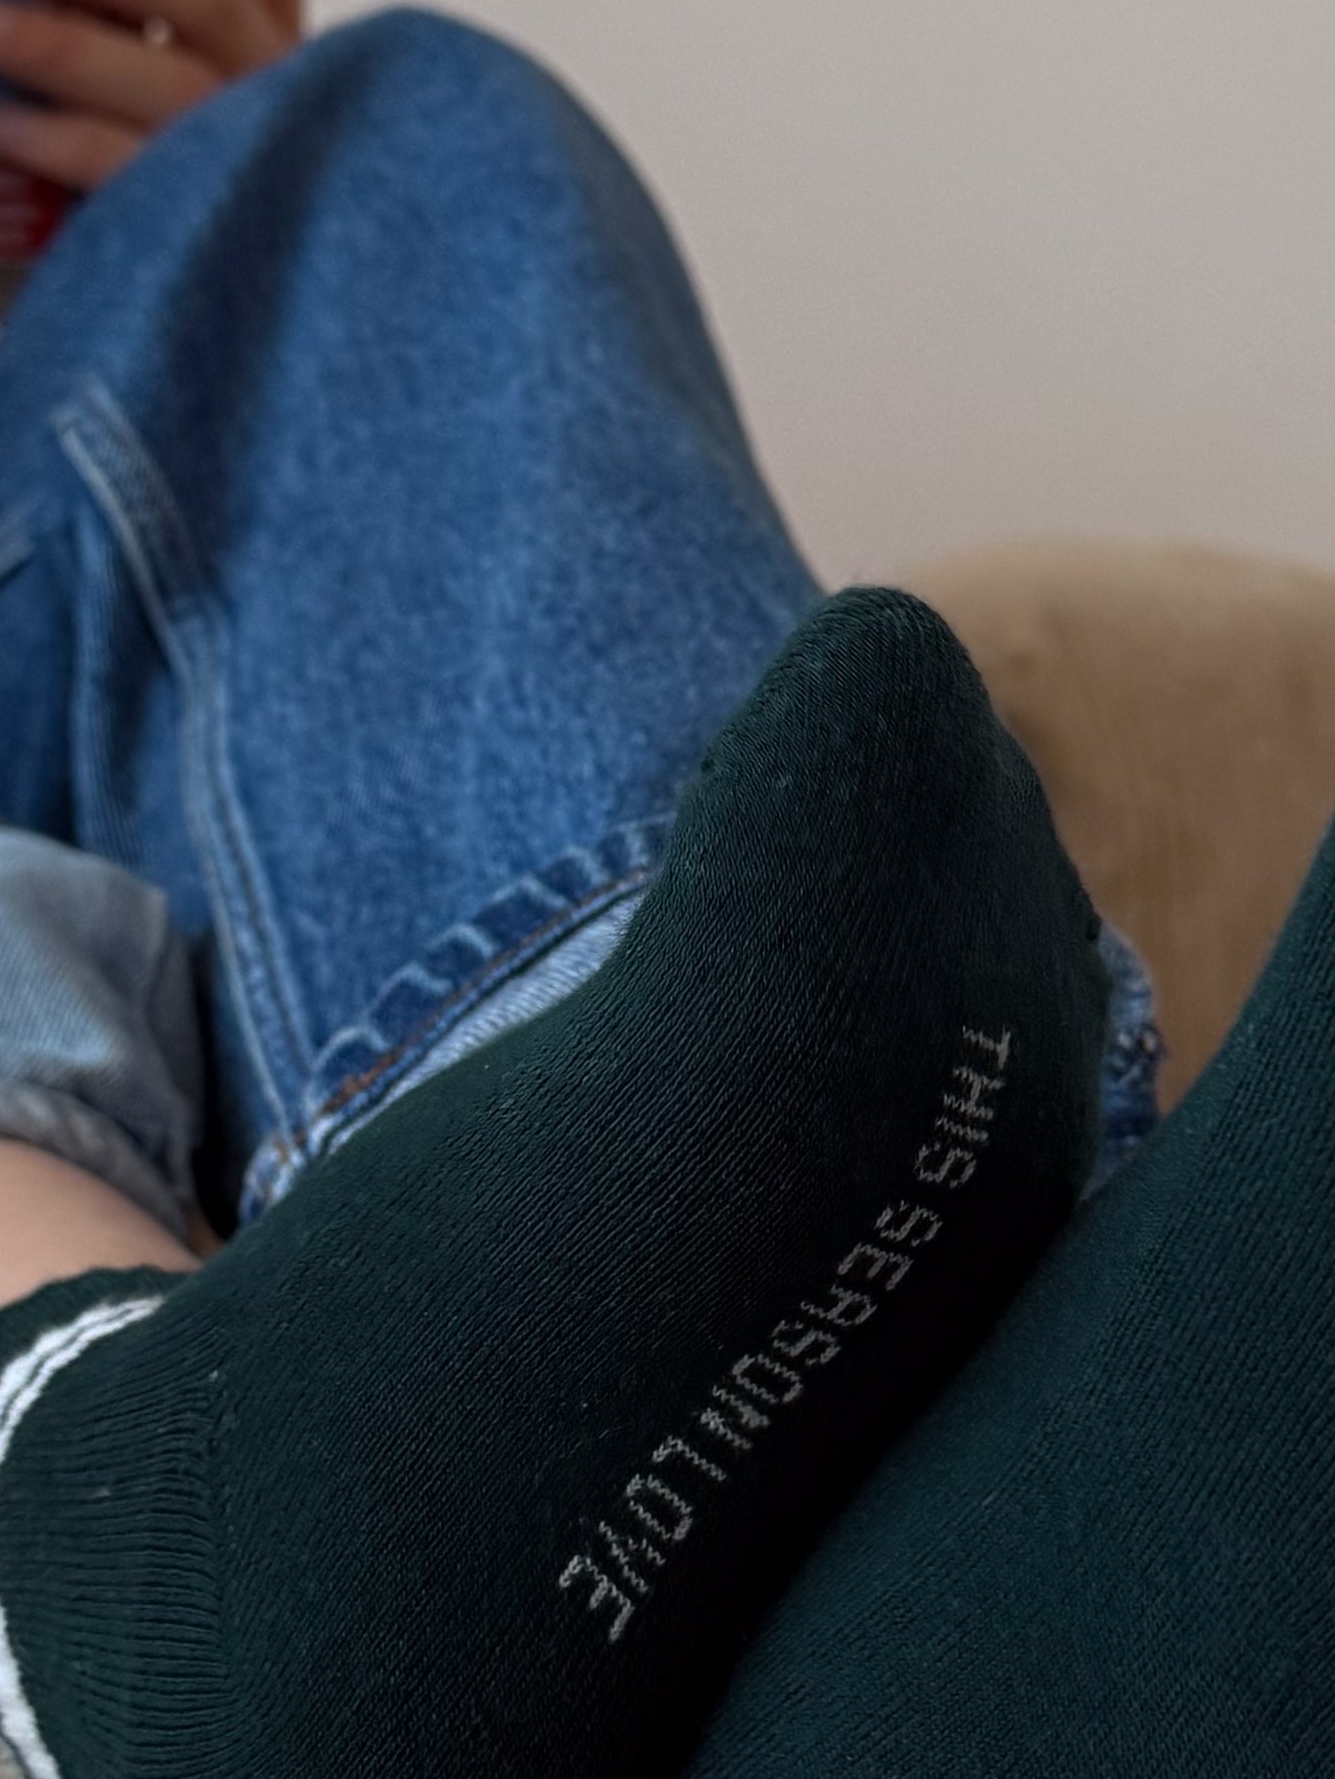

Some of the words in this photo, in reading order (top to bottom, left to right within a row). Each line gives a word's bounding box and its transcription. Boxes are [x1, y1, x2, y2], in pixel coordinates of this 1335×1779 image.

[915, 1024, 1016, 1191] THIS
[699, 1199, 945, 1451] SEASON
[558, 1435, 728, 1644] LOVE
